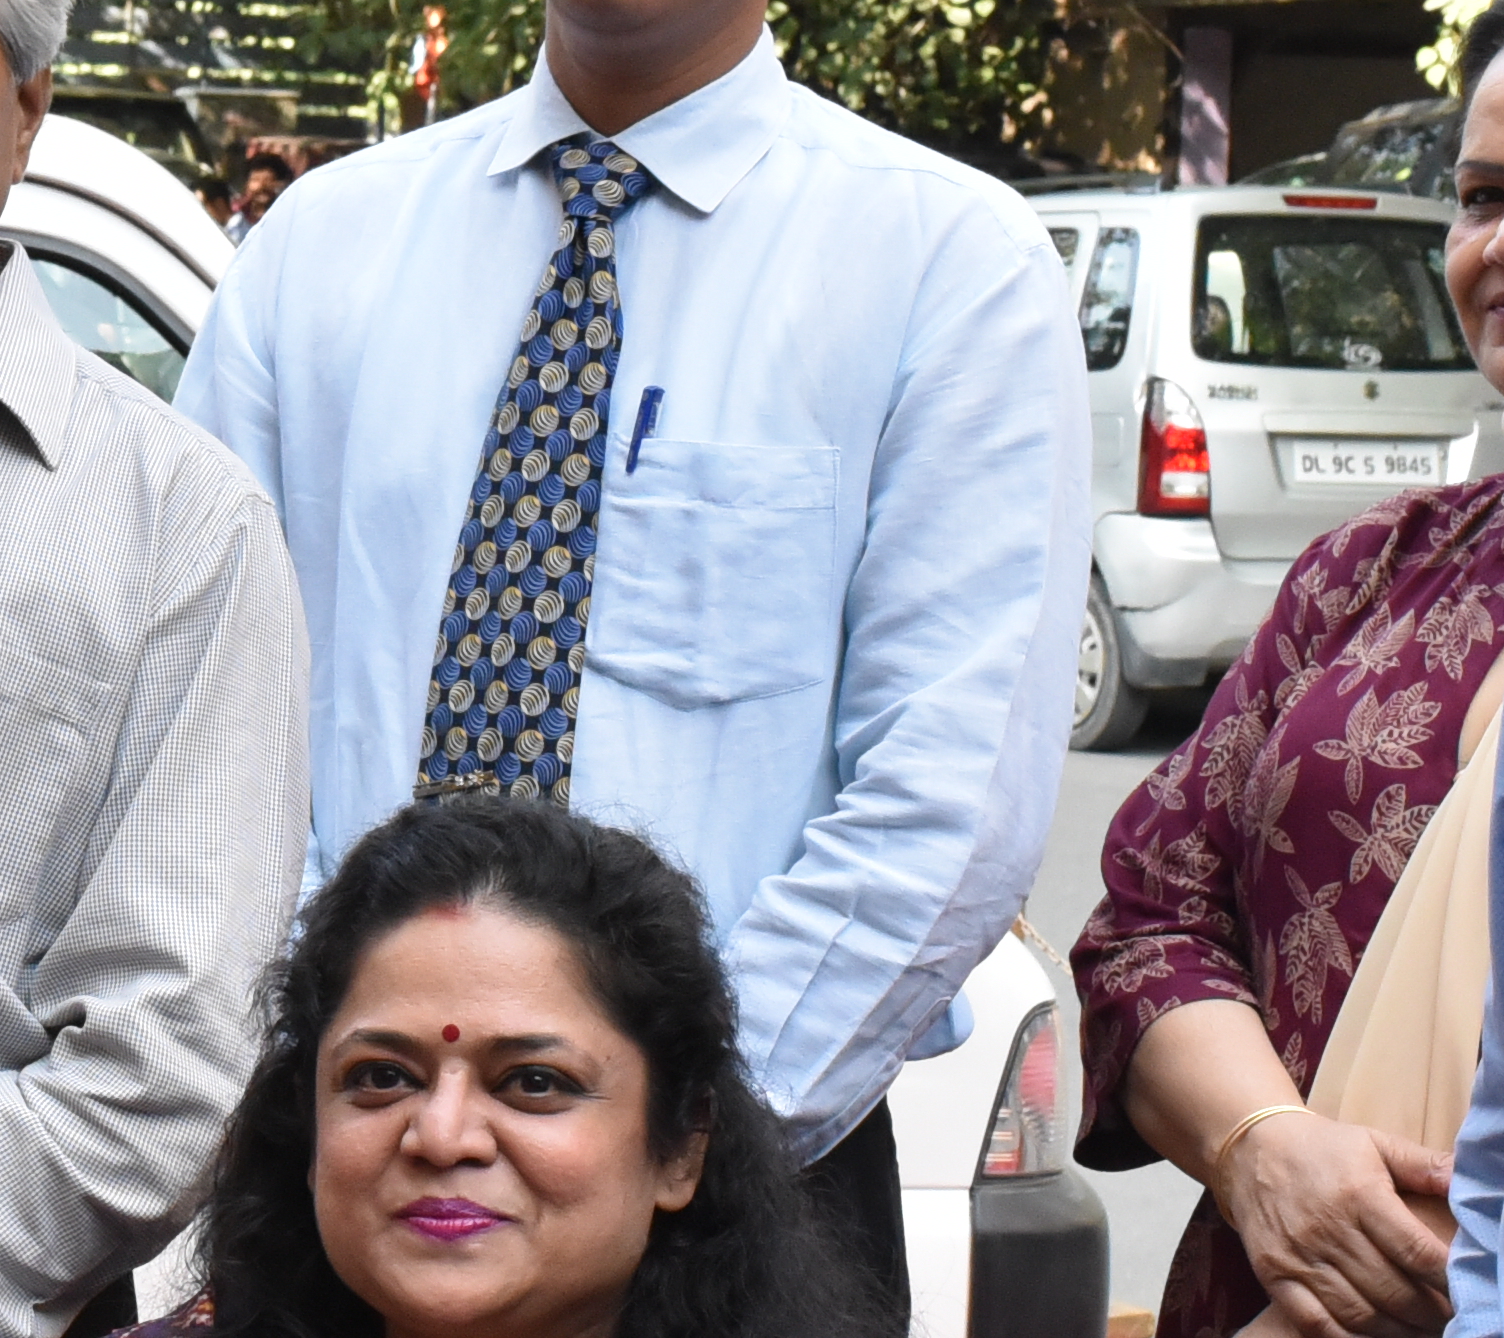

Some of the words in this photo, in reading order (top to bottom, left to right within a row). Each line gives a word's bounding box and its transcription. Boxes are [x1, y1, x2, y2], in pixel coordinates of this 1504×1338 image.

[1302, 454, 1327, 473] DL
[1332, 455, 1355, 474] 9C
[1384, 455, 1432, 476] 9845
